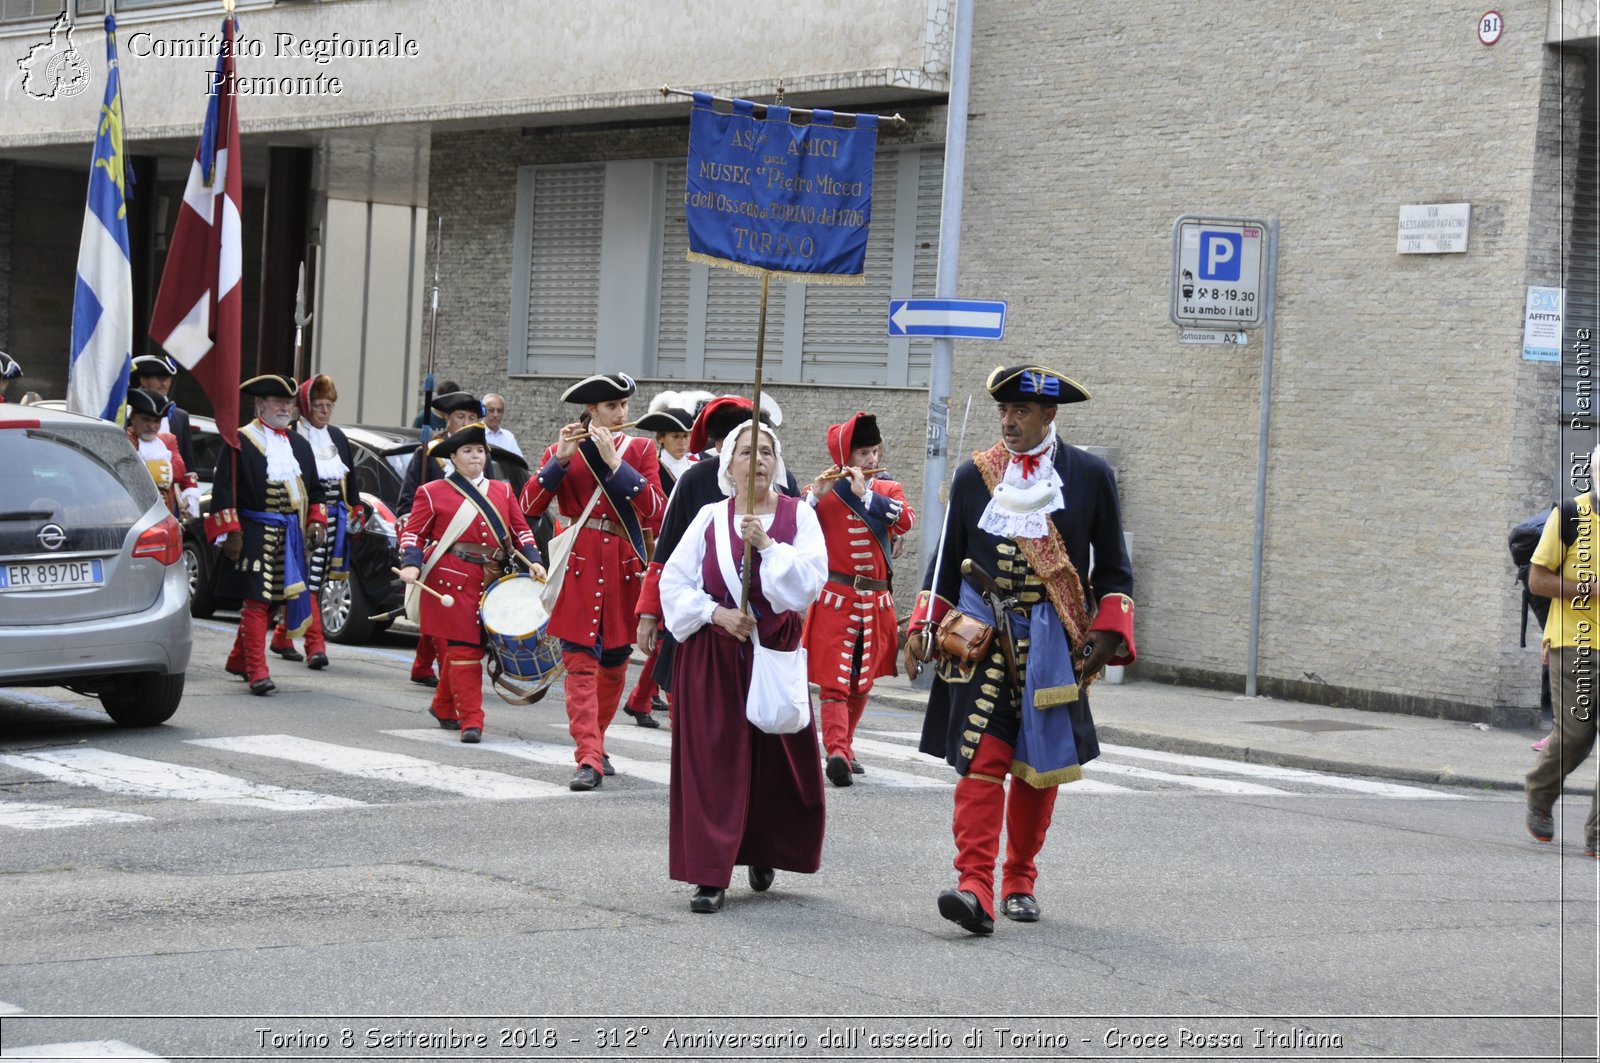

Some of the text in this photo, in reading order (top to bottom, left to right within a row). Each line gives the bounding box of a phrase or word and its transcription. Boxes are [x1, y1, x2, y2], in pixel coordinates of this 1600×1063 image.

[787, 137, 839, 158] AMICI
[763, 154, 788, 166] DEL
[815, 173, 862, 197] Micca
[769, 202, 815, 225] TORINO
[817, 209, 837, 226] del
[1427, 207, 1439, 217] VIA
[735, 227, 814, 258] TORINO
[1207, 236, 1234, 275] P
[1183, 305, 1195, 314] su
[1198, 305, 1226, 316] ambo
[1235, 306, 1253, 317] lati
[1178, 331, 1216, 341] Sottozona
[9, 565, 31, 584] ER
[38, 562, 89, 584] 897DF
